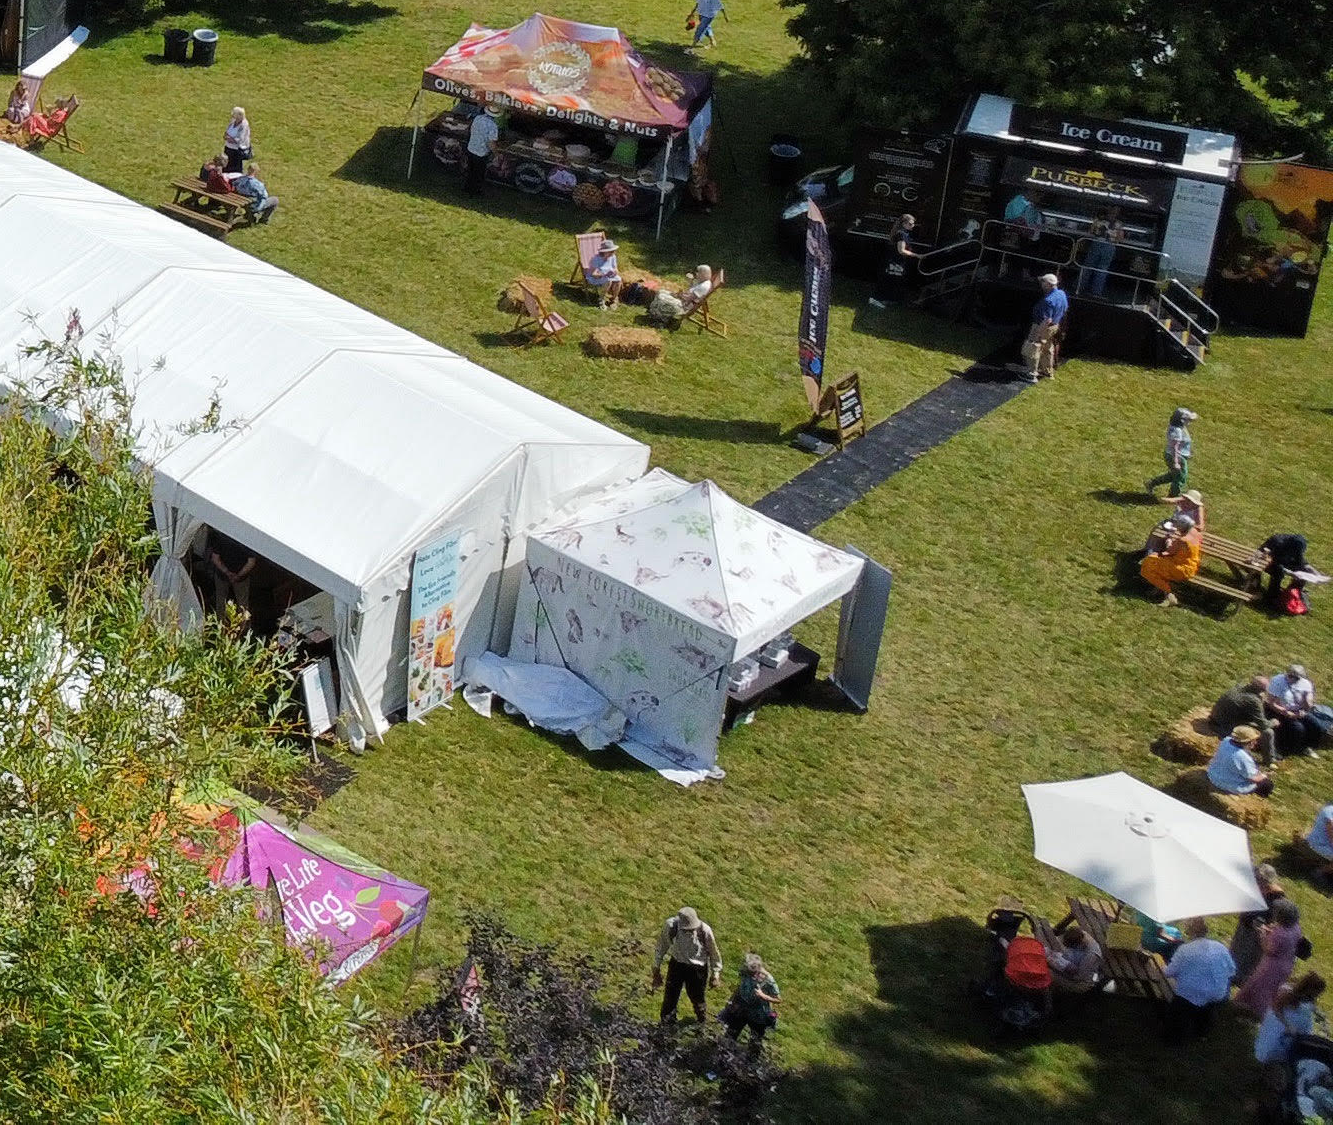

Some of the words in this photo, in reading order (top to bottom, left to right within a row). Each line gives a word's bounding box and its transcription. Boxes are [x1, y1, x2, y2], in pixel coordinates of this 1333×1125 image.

[434, 78, 480, 101] Olives,
[484, 91, 542, 116] Baklava,
[545, 104, 605, 128] Delights
[608, 117, 621, 131] &
[623, 120, 659, 138] Nuts
[1060, 122, 1091, 140] Ice
[1096, 128, 1163, 153] Cream
[557, 557, 581, 579] NEW
[587, 571, 629, 602] FOREST
[631, 592, 703, 641] SHORTBREAD
[285, 889, 357, 932] Veg
